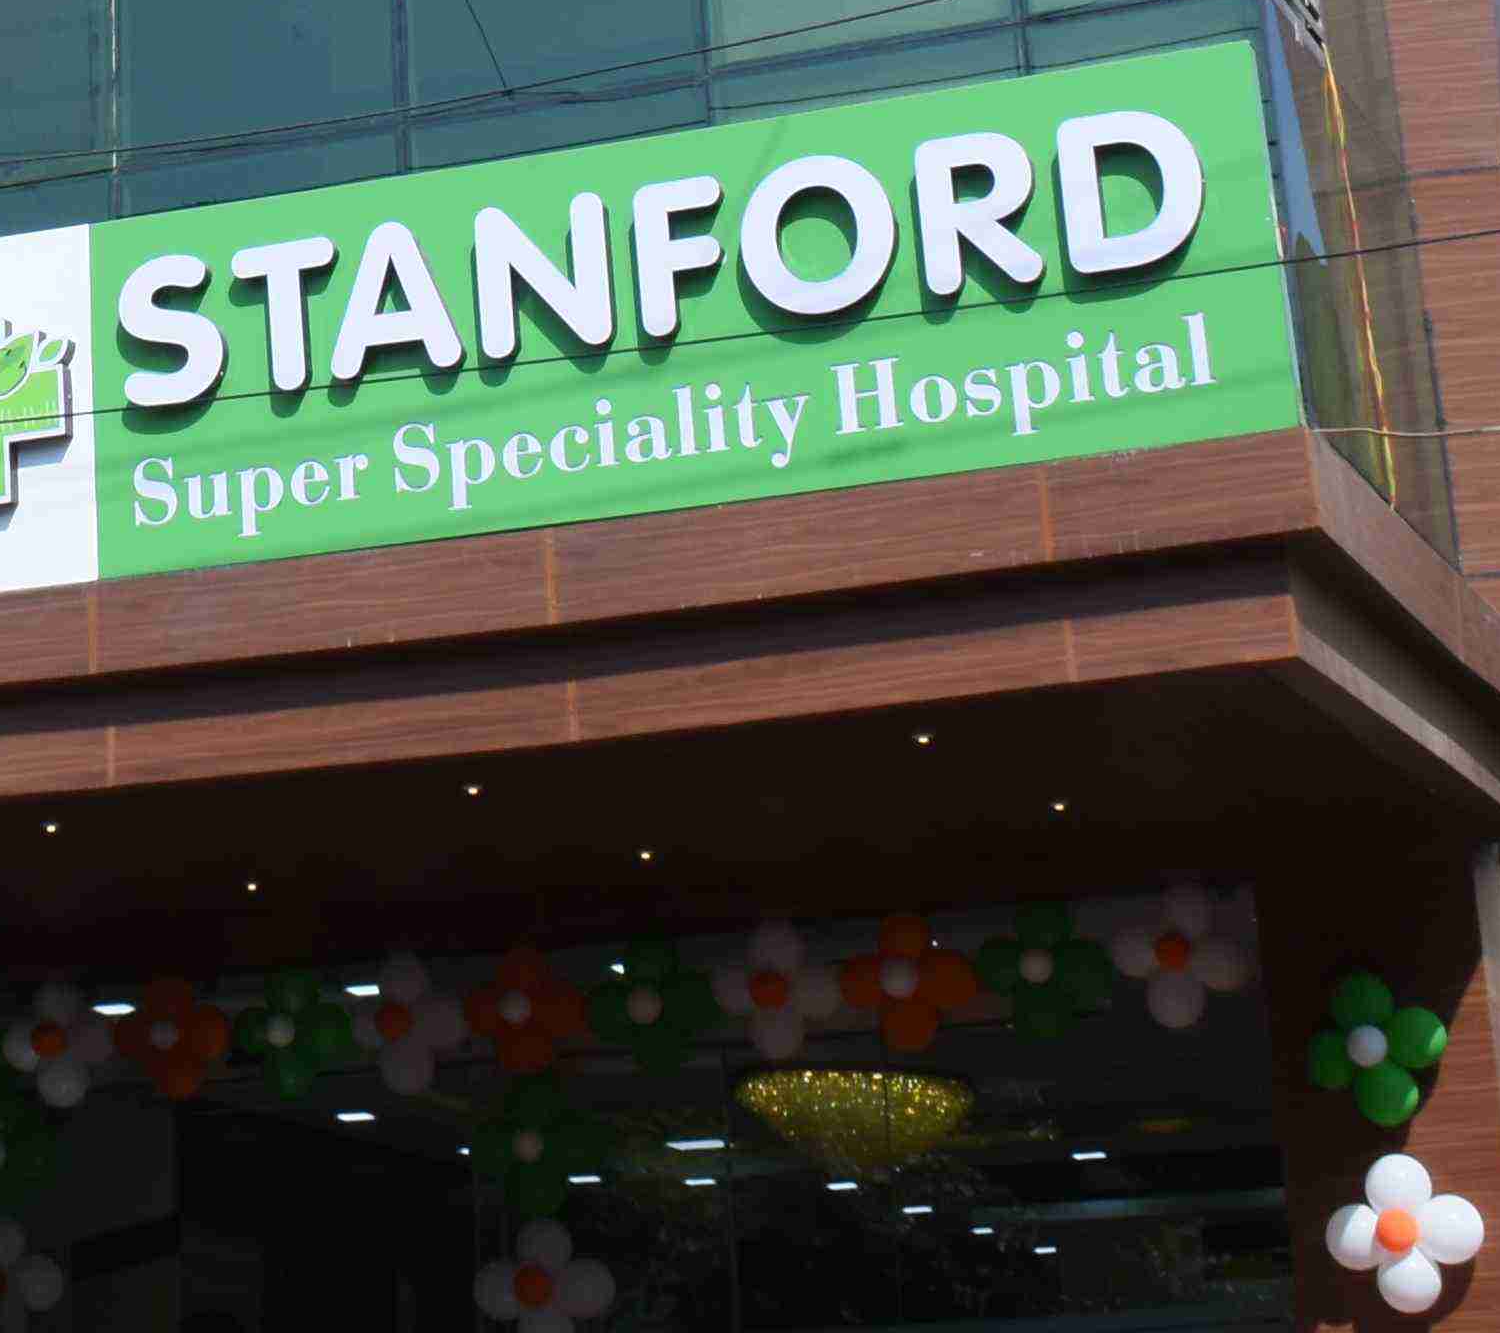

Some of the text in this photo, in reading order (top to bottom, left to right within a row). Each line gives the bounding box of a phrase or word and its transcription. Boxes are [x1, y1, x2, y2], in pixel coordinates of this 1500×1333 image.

[117, 110, 1206, 407] STANFORD
[131, 311, 1217, 539] Super Speciality Hospital
